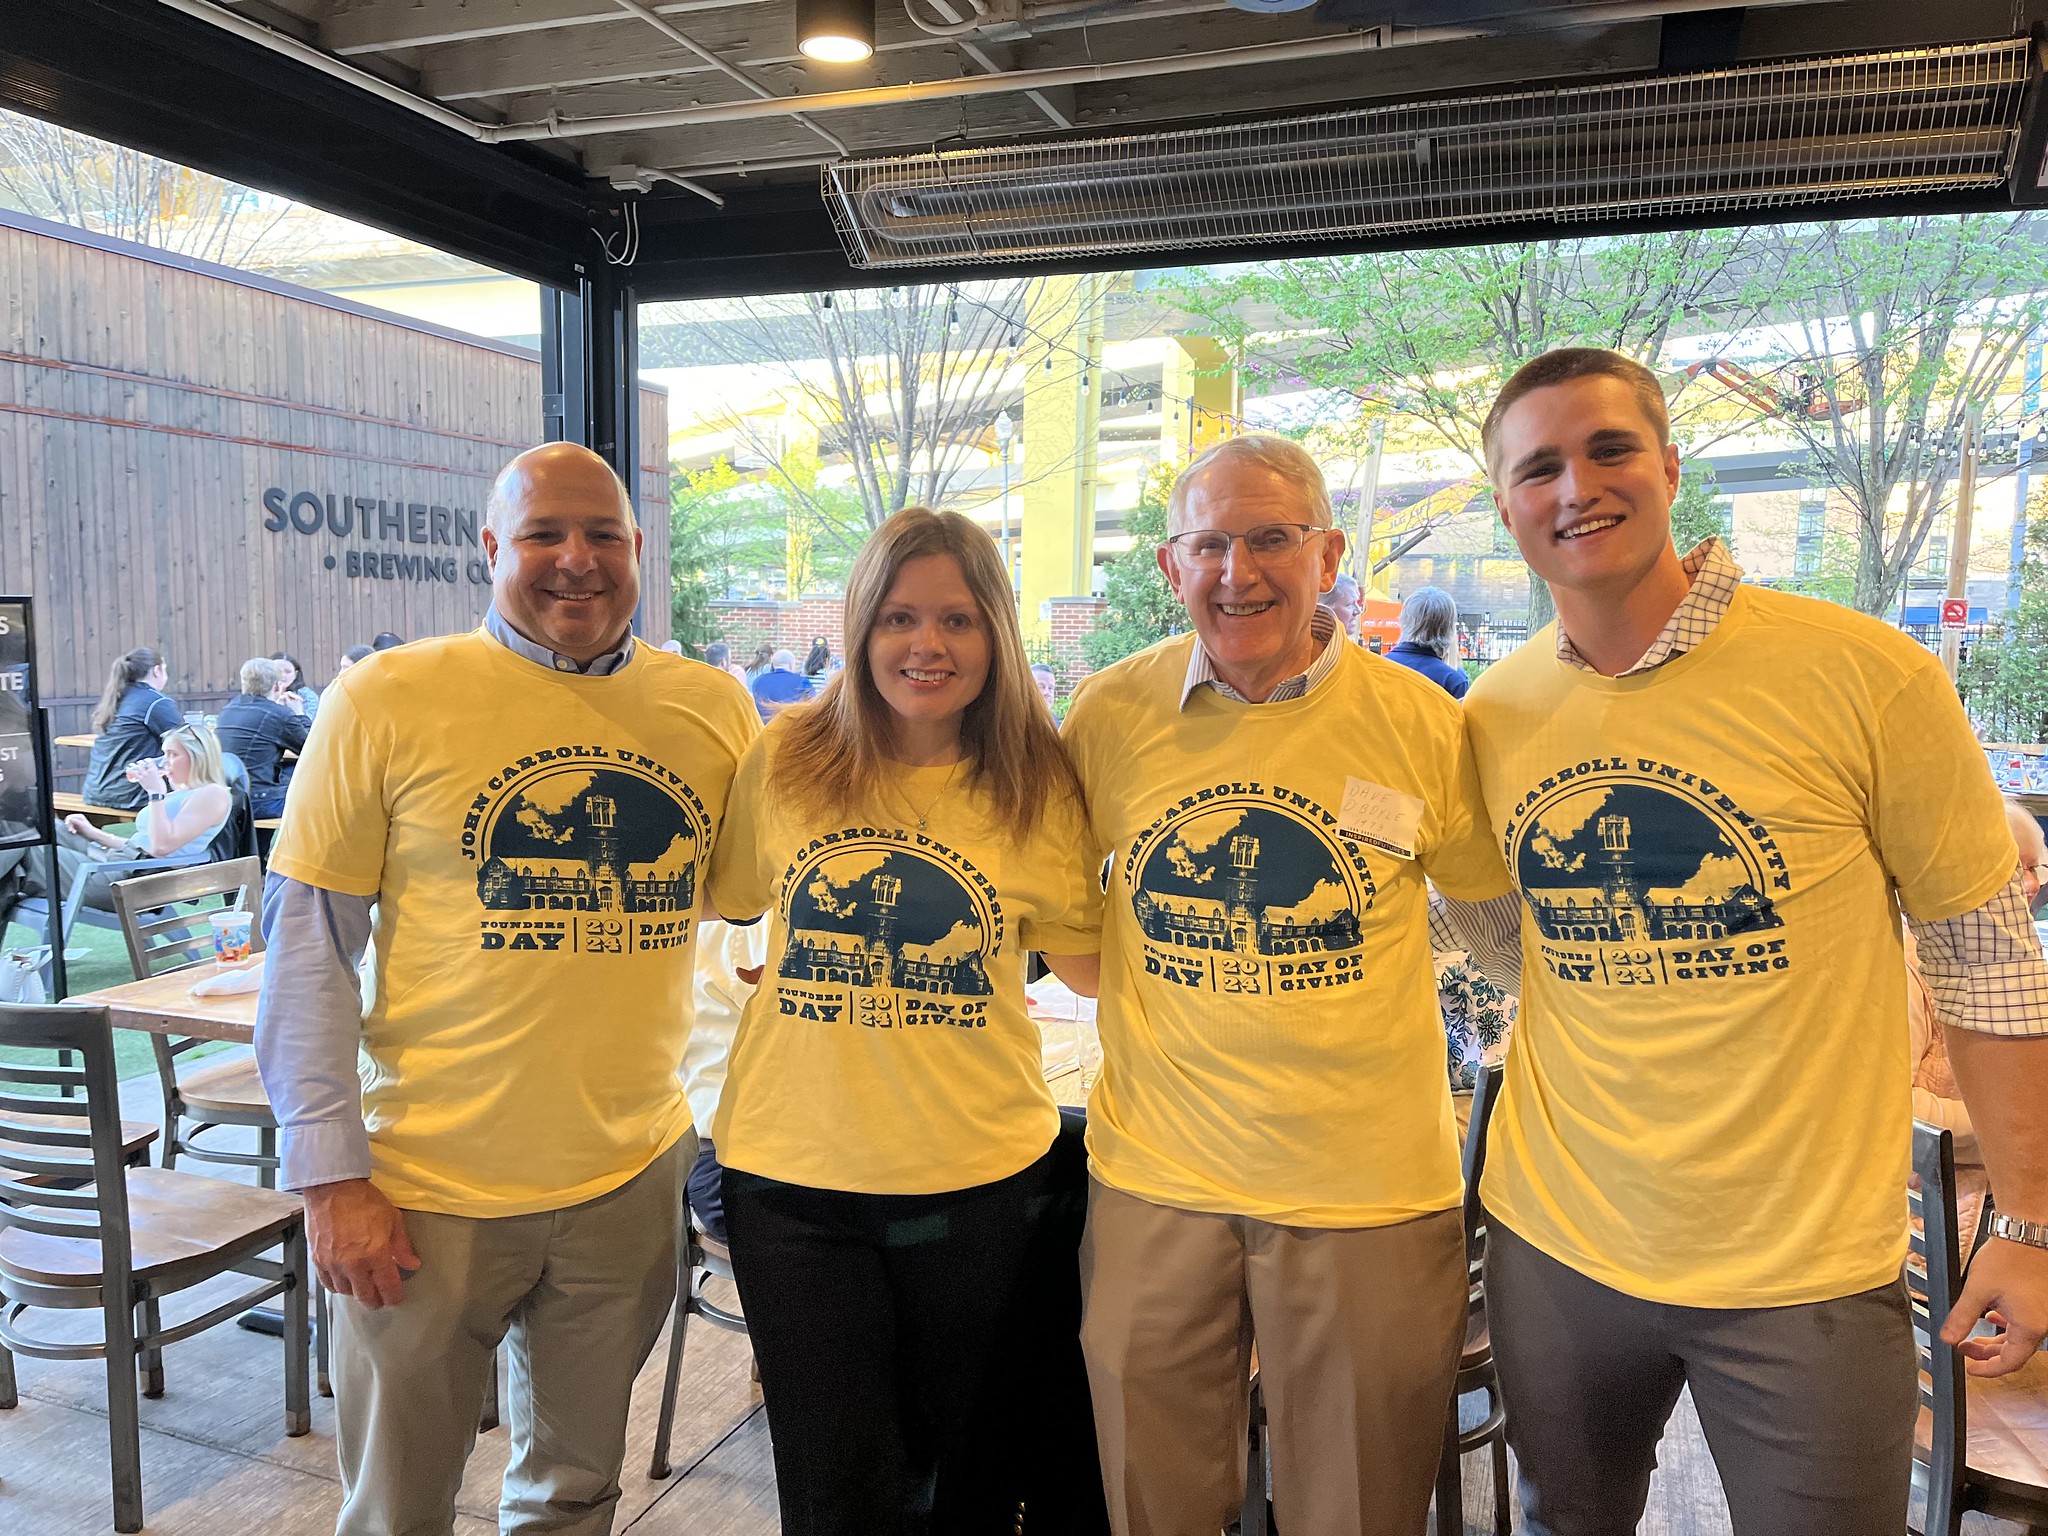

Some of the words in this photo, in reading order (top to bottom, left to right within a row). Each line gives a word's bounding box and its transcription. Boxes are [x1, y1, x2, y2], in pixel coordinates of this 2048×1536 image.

[263, 487, 478, 548] SOUTHERN
[346, 551, 457, 583] BREWING
[461, 792, 490, 860] JOHN
[488, 745, 609, 791] CARROLL
[1515, 757, 1628, 817] CARROLL
[1637, 758, 1791, 891] UNIVERSITY
[1125, 829, 1154, 886] JOHN
[1151, 782, 1265, 829] CARROLL
[796, 827, 908, 861] CARROLL
[916, 833, 1004, 958] UNIVERSITY
[480, 921, 565, 929] FOUNDERS
[585, 918, 623, 936] 20
[639, 922, 676, 938] DAY
[677, 918, 691, 933] OF
[480, 932, 565, 950] DAY
[585, 936, 623, 954] 24
[639, 932, 688, 950] GIVING
[1143, 944, 1203, 967] FOUNDERS
[1610, 948, 1653, 965] 20
[1672, 947, 1735, 964] DAY
[1746, 939, 1787, 957] OF
[1145, 955, 1204, 988] DAY
[1222, 958, 1260, 976] 20
[1278, 960, 1329, 977] DAY
[1334, 954, 1363, 969] OF
[1676, 956, 1790, 980] GIVING
[1223, 976, 1260, 993] 24
[1280, 968, 1364, 992] GIVING
[1616, 966, 1656, 985] 24
[777, 987, 843, 1001] FOUNDERS
[859, 994, 892, 1010] 20
[779, 998, 843, 1023] DAY
[905, 999, 955, 1015] DAY
[961, 1001, 988, 1016] OF
[859, 1011, 893, 1028] 24
[905, 1015, 987, 1028] GIVING
